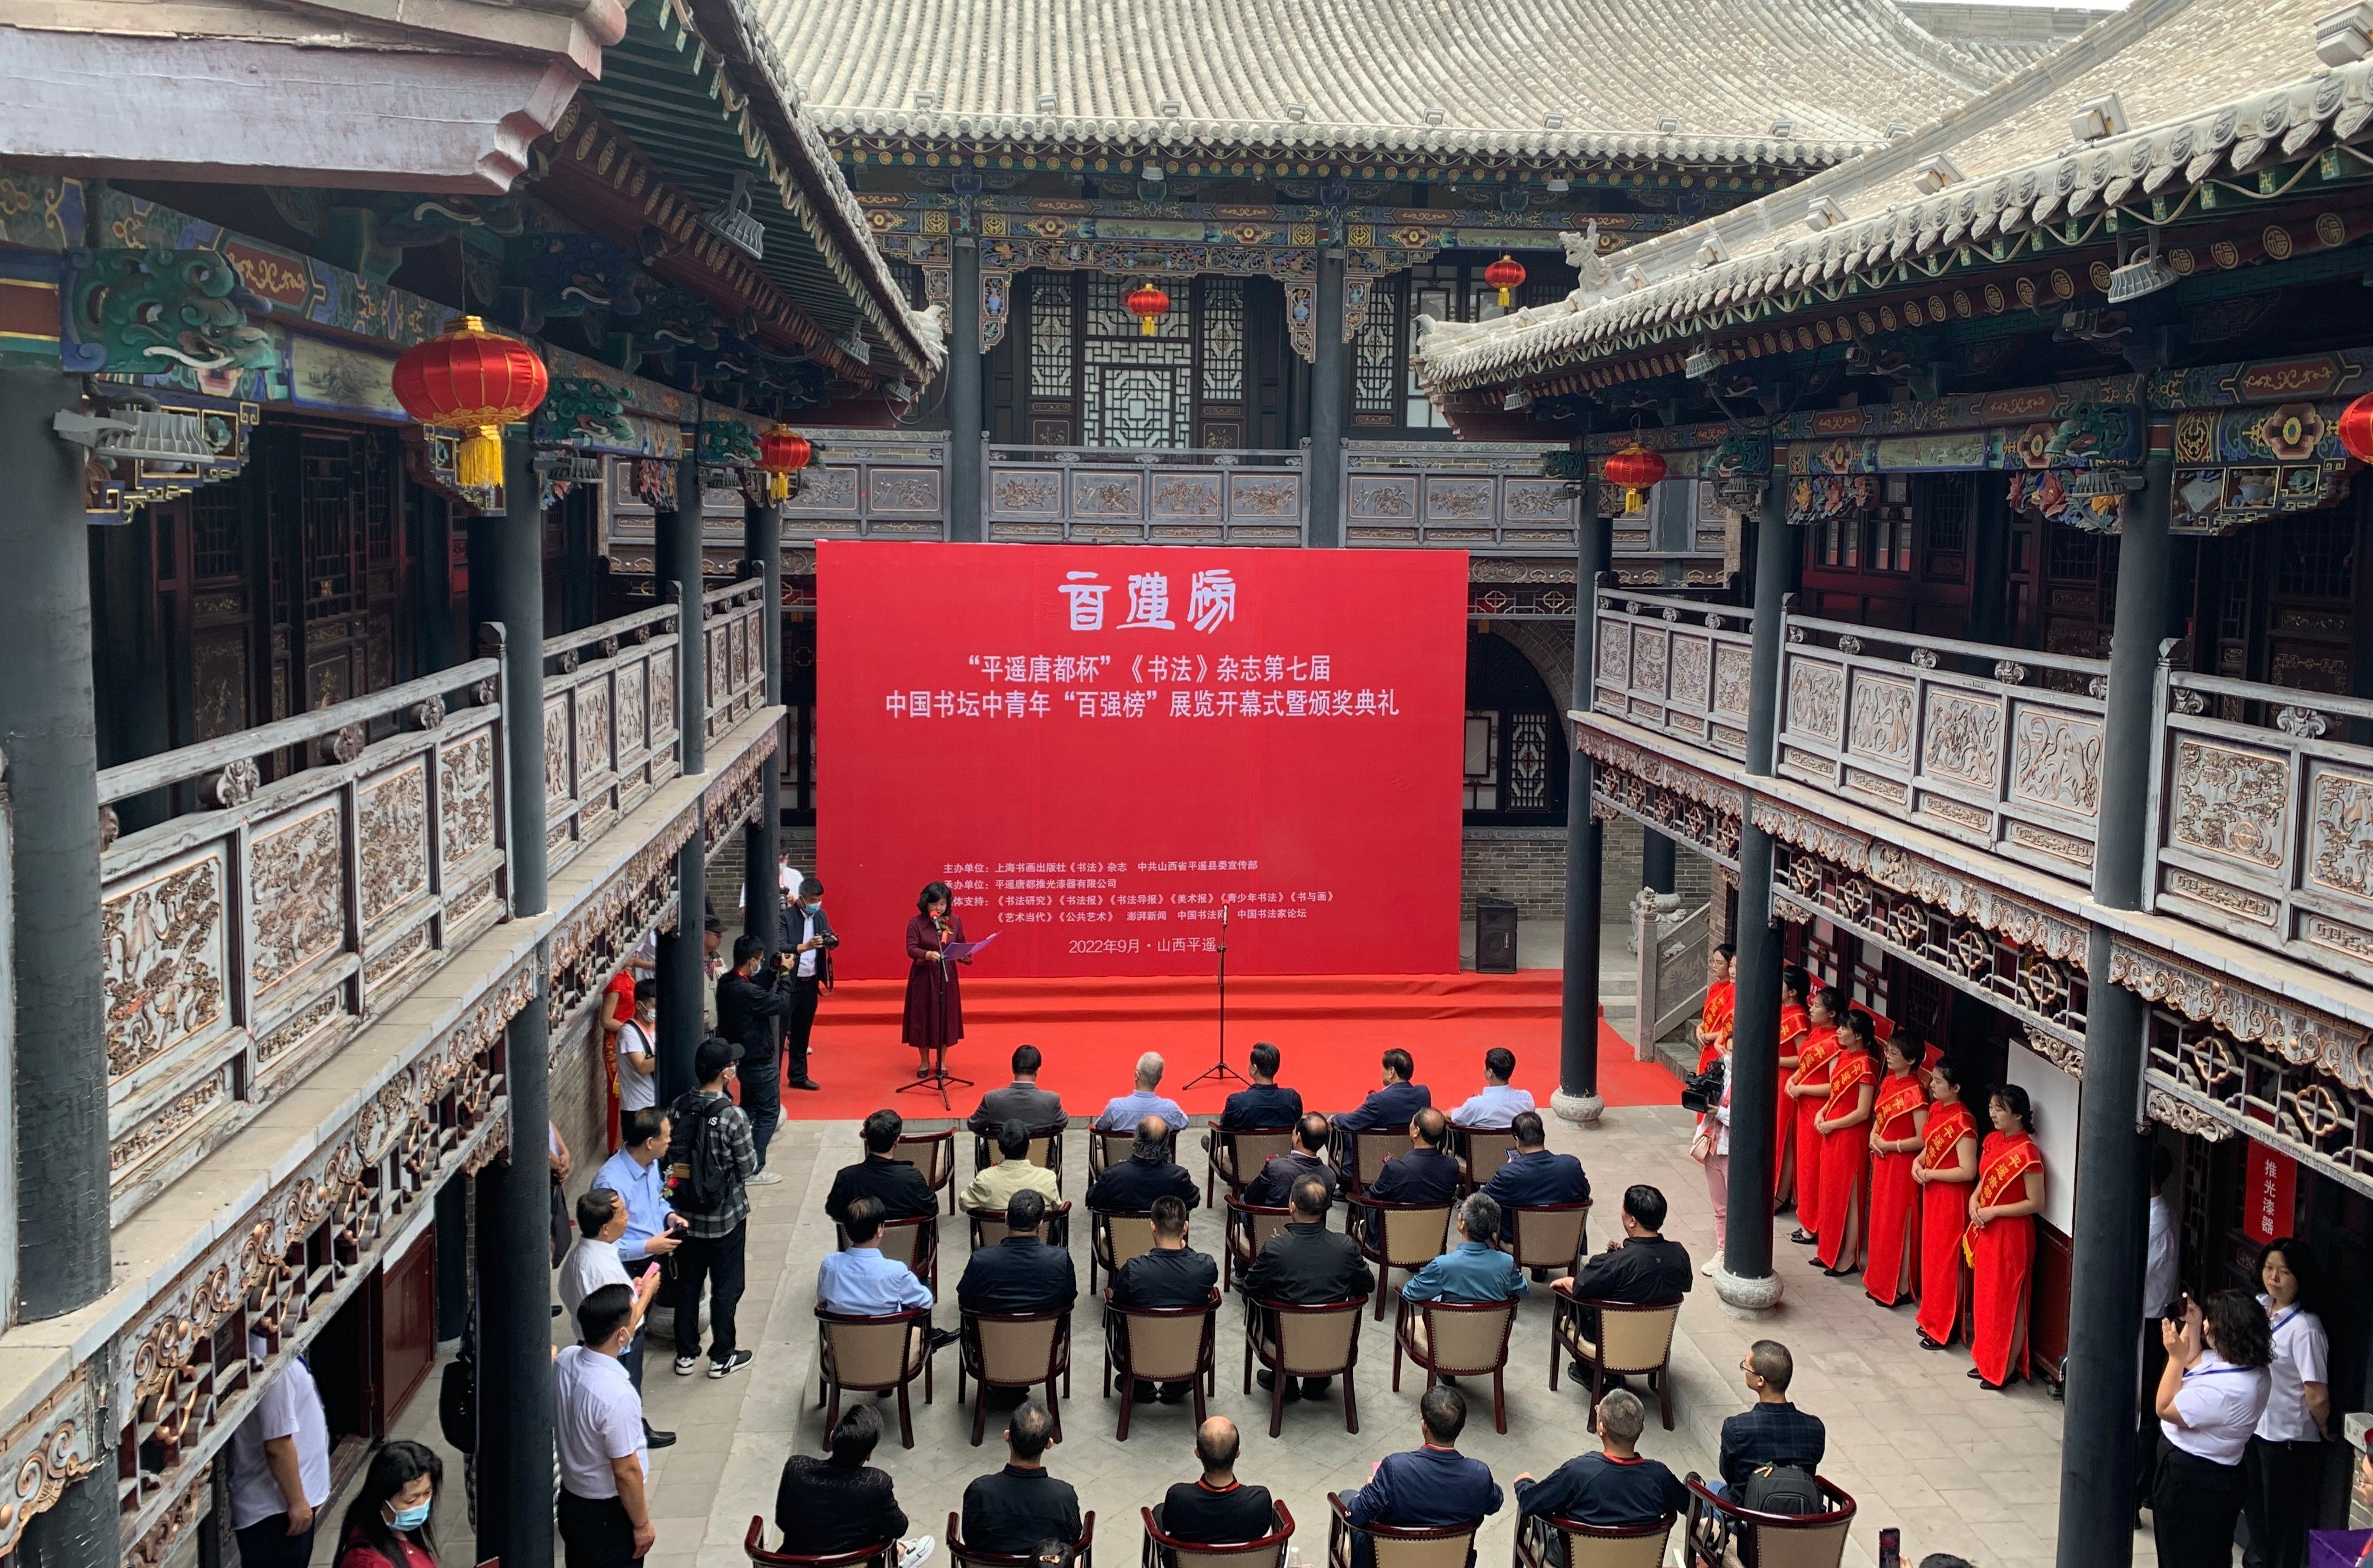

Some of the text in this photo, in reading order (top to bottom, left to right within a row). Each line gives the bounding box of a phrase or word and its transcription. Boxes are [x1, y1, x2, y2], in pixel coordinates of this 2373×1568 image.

[952, 891, 1334, 906] 体支持：《书法研究》《书法报》《书法导报》《美术报》《青少年书法》《书与画》
[1126, 911, 1166, 922] 澎湃新闻
[1237, 908, 1307, 920] 中国书法家论坛
[2262, 1159, 2276, 1235] 推光漆器
